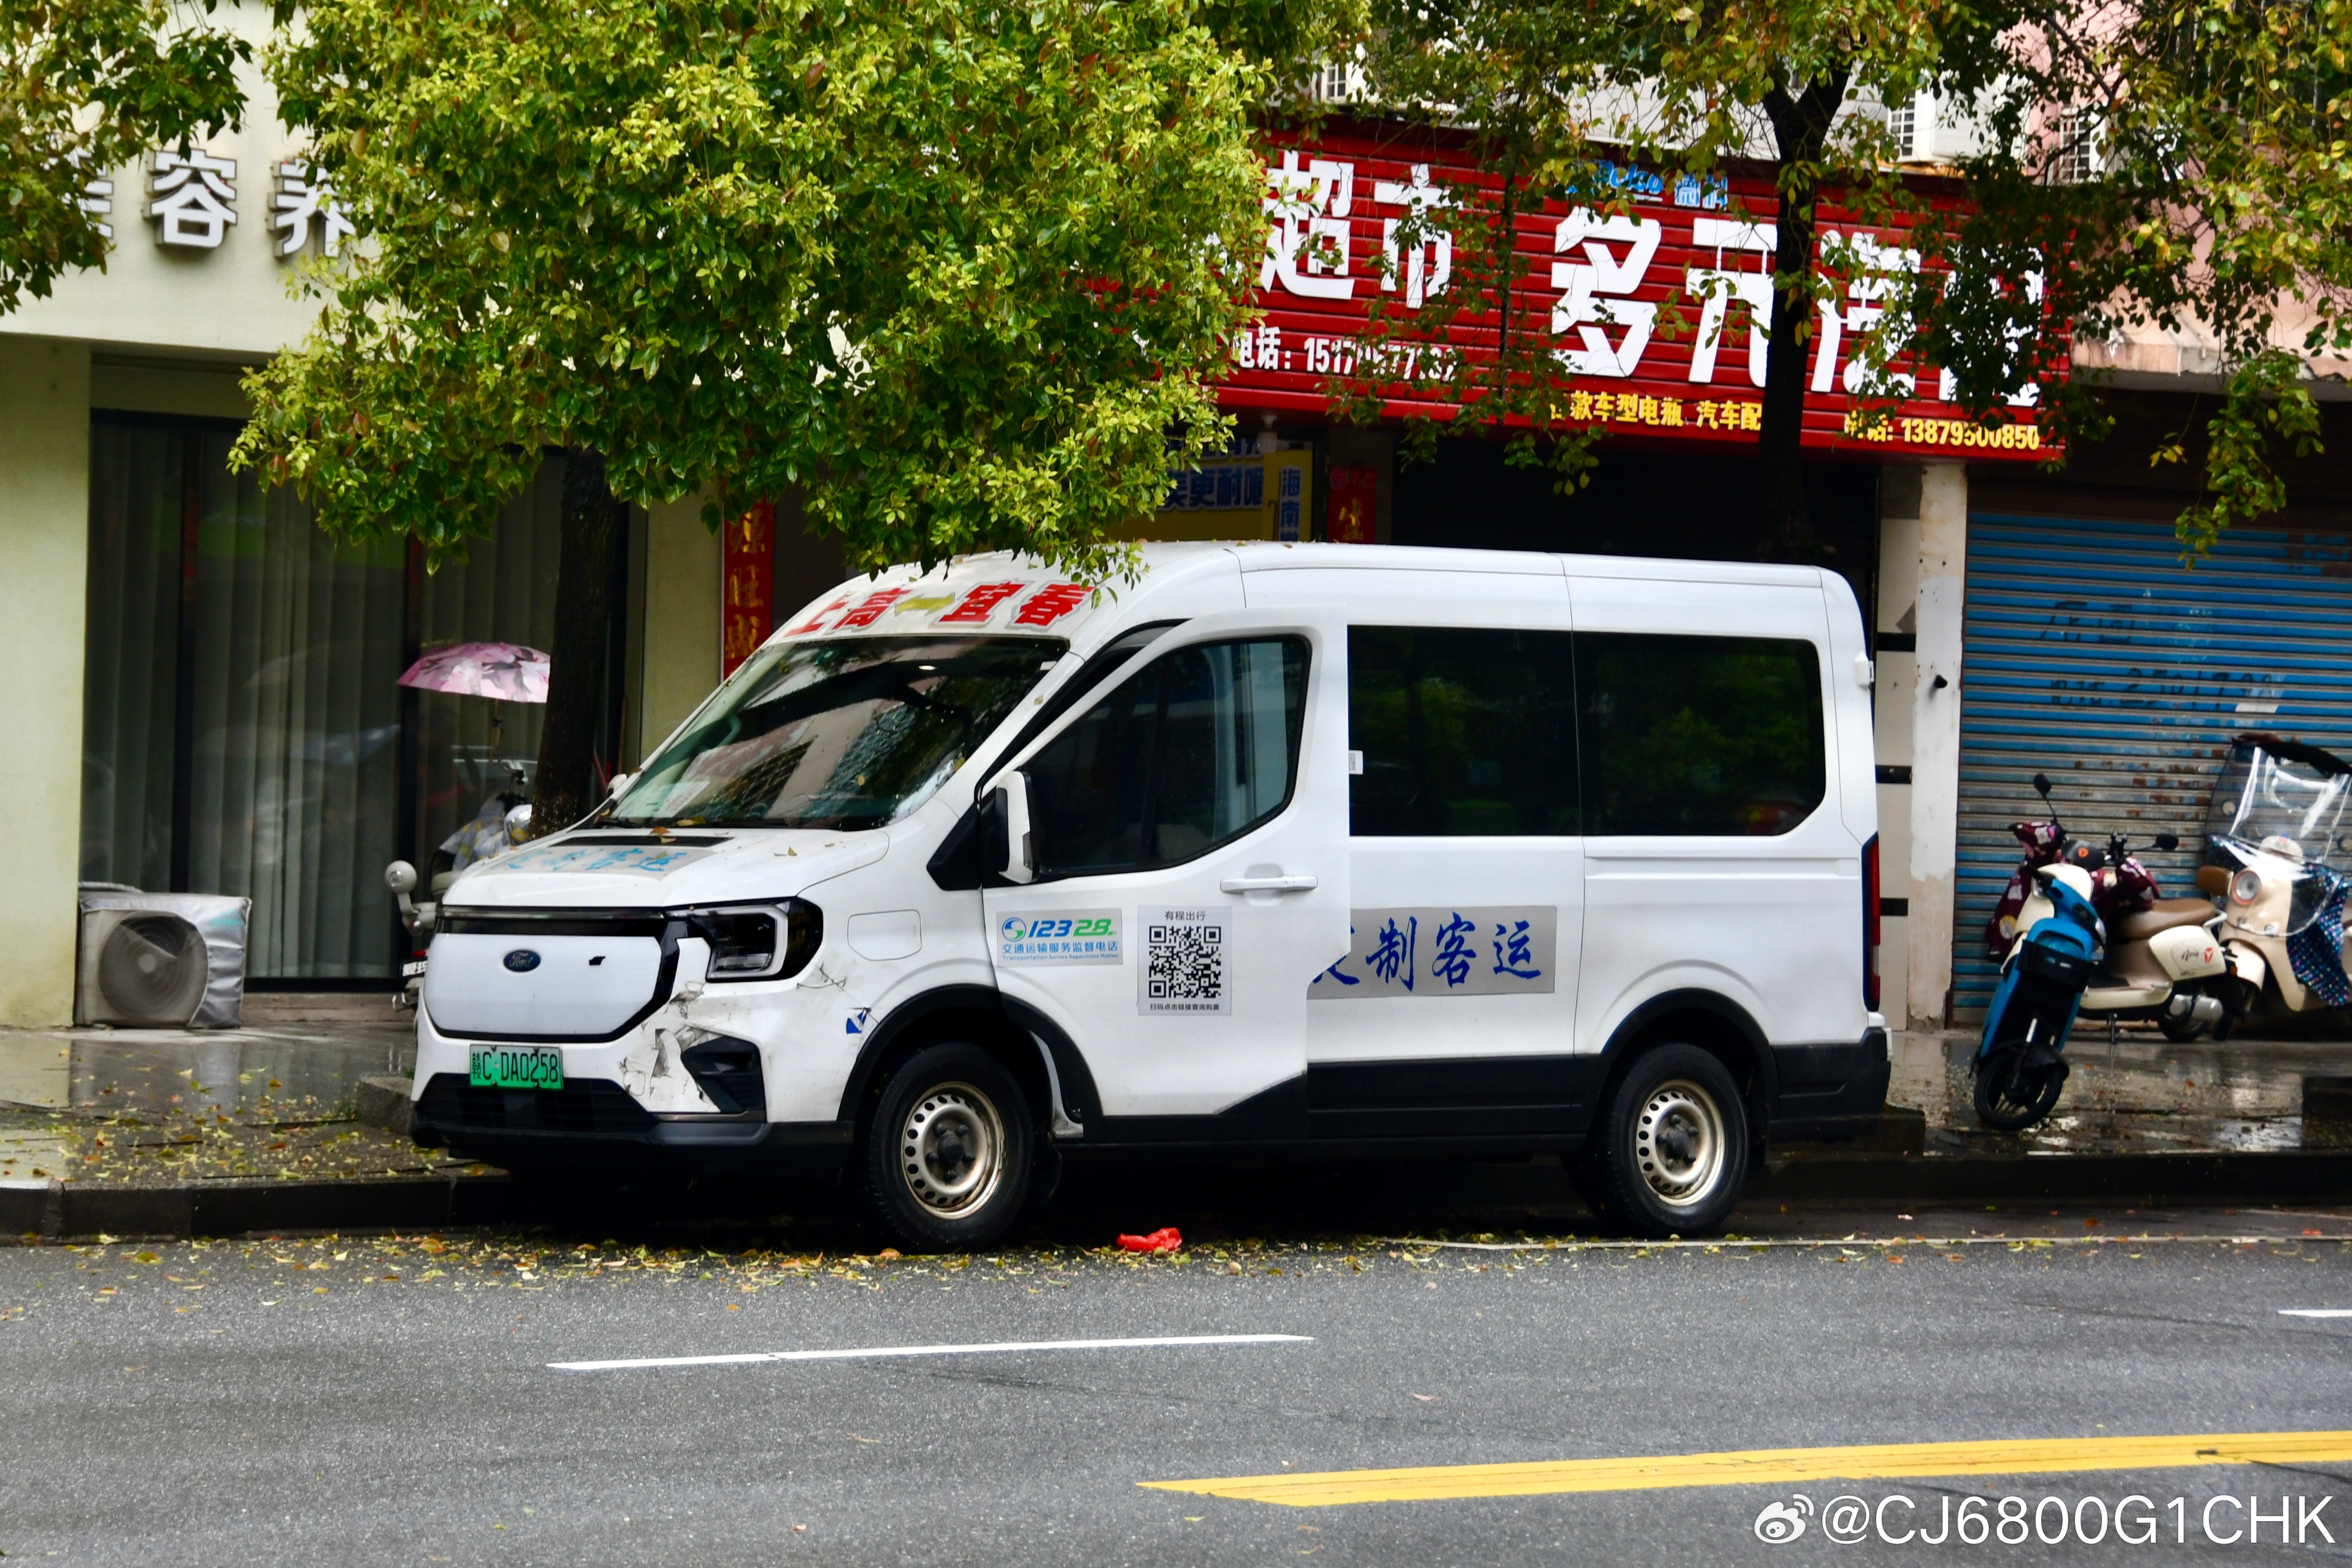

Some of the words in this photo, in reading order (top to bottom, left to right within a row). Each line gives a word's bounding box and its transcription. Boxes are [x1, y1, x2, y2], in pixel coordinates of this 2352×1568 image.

[49, 148, 356, 258] 容养
[1551, 390, 1683, 427] 款车型电瓶
[938, 582, 1095, 627] 宜春
[1165, 911, 1206, 921] 有程出行
[1028, 919, 1116, 938] 12328
[1002, 940, 1118, 954] 交通运输服务监督电话
[509, 952, 534, 968] Ford
